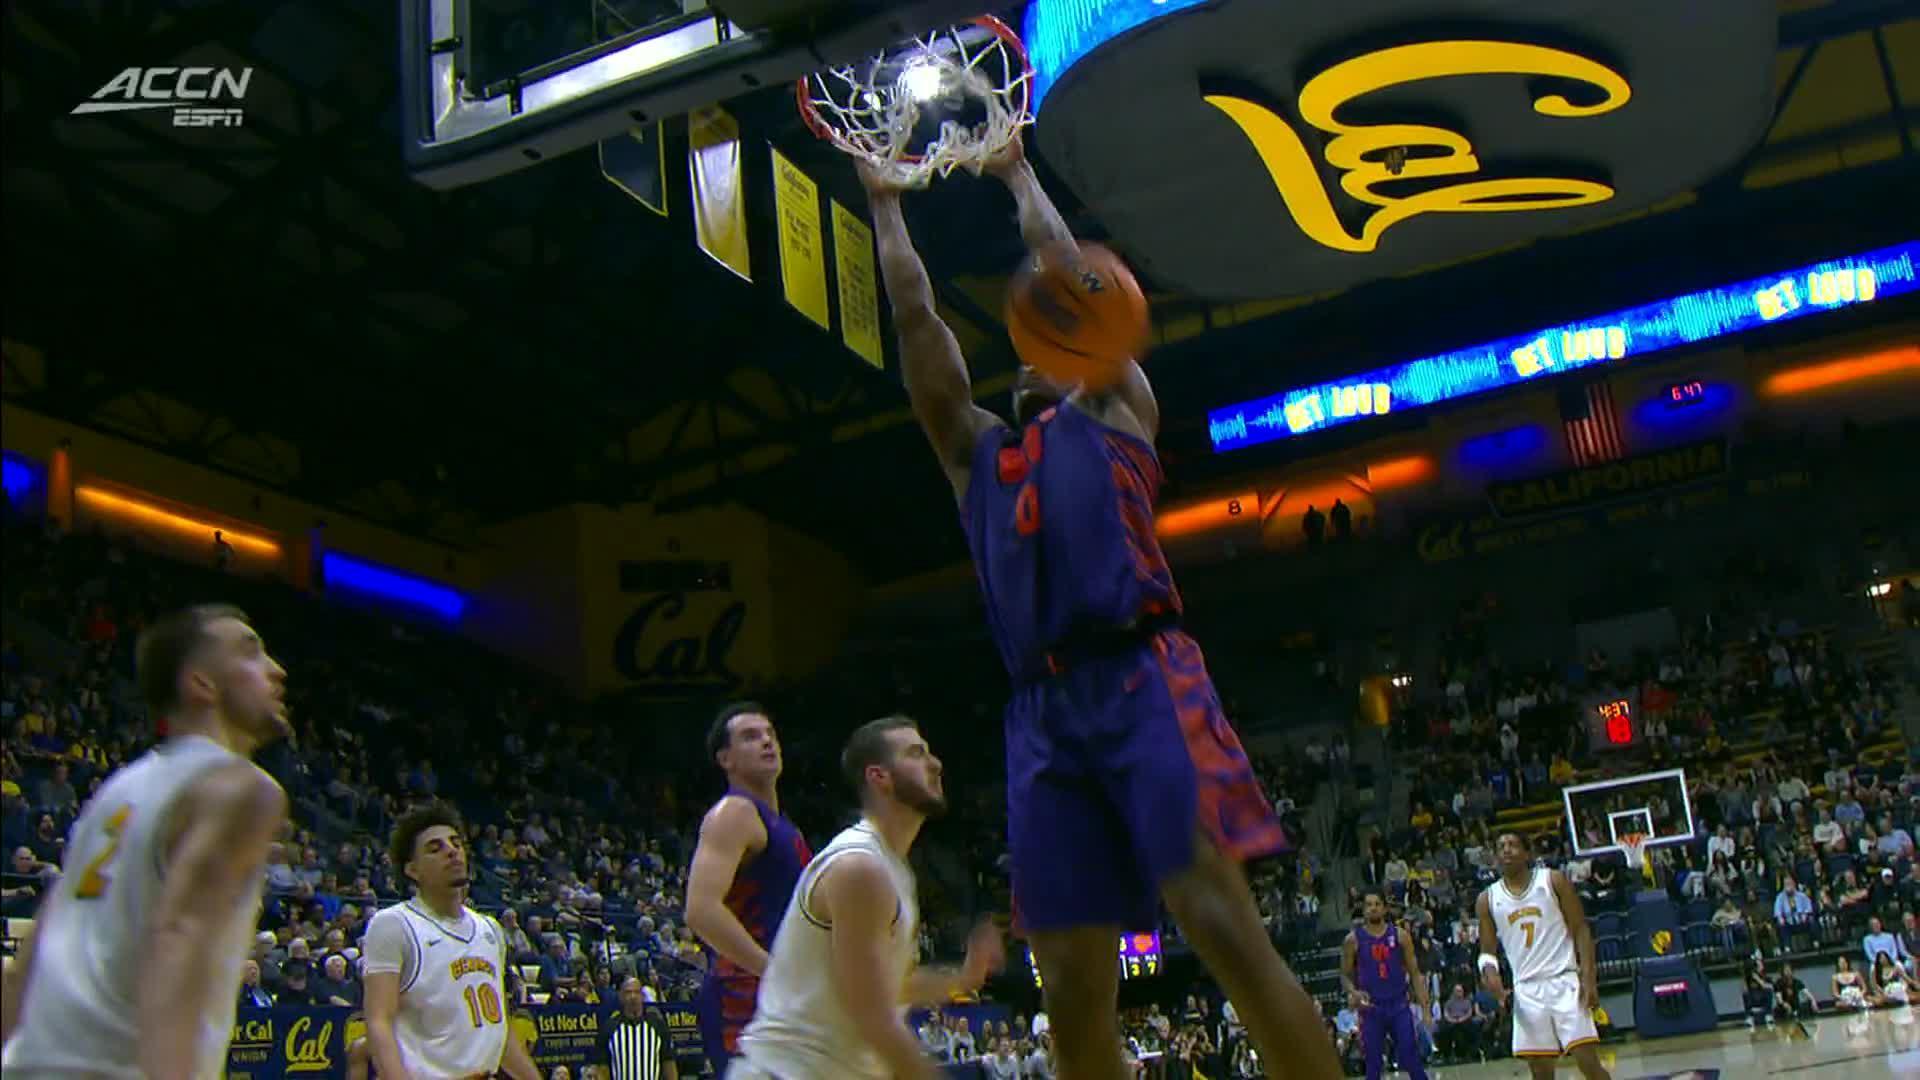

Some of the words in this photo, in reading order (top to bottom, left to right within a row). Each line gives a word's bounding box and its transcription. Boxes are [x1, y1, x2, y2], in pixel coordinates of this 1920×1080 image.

[1203, 40, 1632, 253] Cal
[1757, 277, 1801, 321] GET
[1807, 269, 1876, 305] LOUD
[1511, 337, 1555, 377] GET
[1563, 325, 1627, 361] LOUD
[1284, 394, 1325, 433] GET
[1332, 383, 1391, 417] LOUD
[1500, 444, 1722, 514] CALIFORNIA
[1015, 483, 1041, 536] 0
[613, 593, 747, 697] Cal
[73, 802, 133, 898] 2
[1520, 922, 1535, 948] 7
[246, 1018, 273, 1041] Cal
[463, 982, 503, 1028] 10
[538, 1014, 558, 1032] 1st
[557, 1013, 577, 1031] Nor
[579, 1012, 598, 1030] Cal
[284, 1015, 335, 1073] Cal
